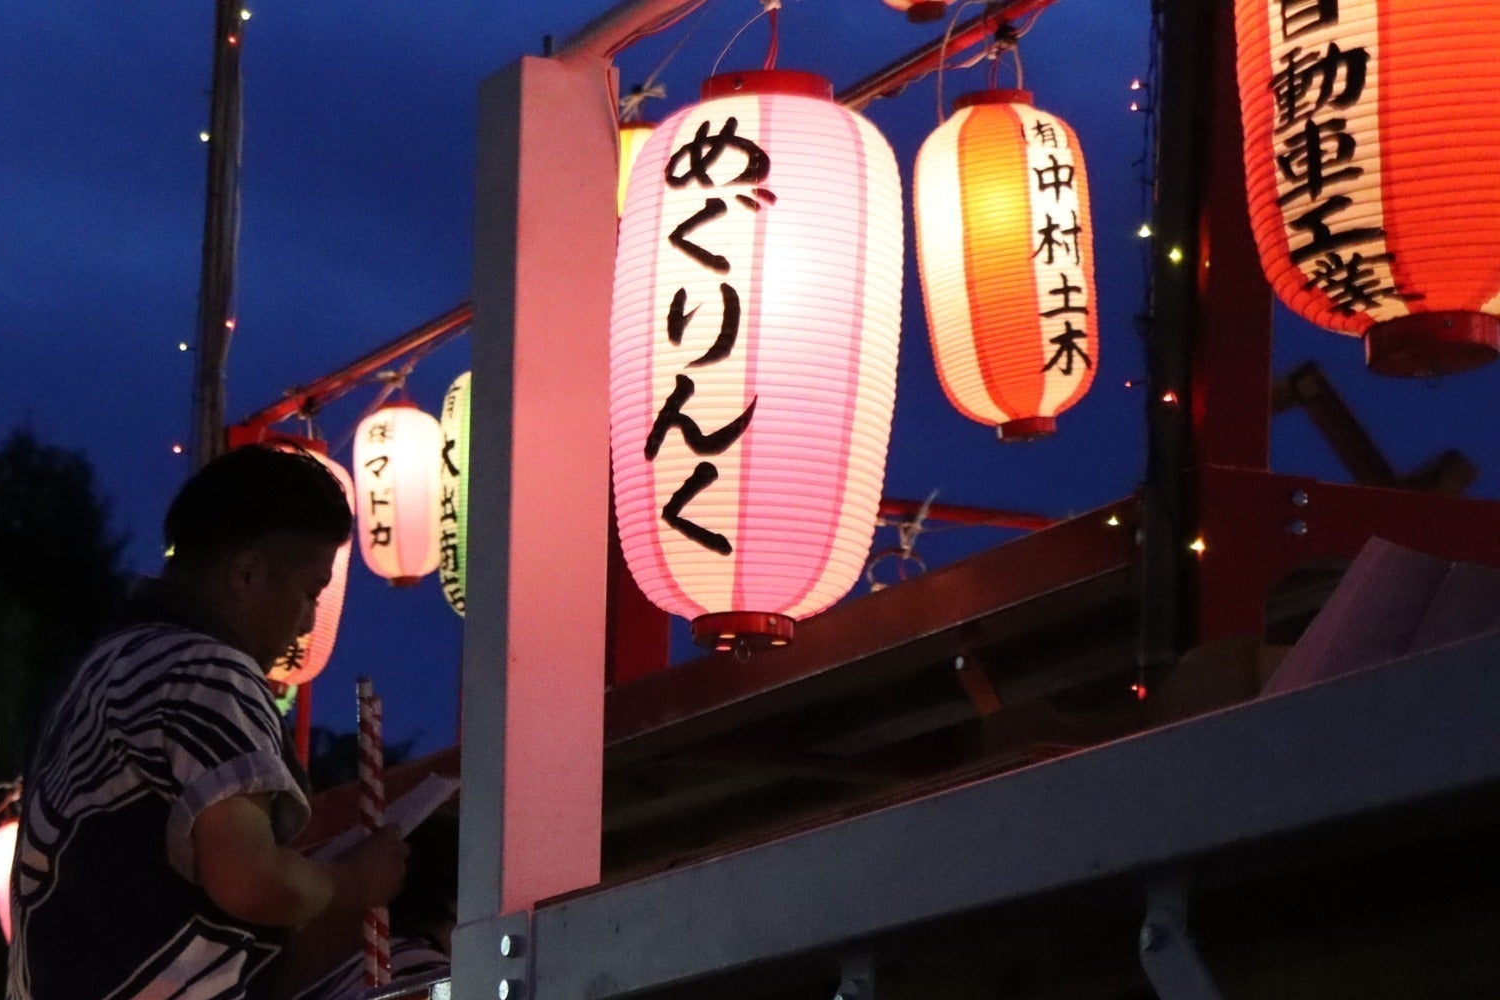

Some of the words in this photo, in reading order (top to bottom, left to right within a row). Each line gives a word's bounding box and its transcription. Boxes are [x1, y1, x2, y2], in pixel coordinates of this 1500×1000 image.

[644, 116, 777, 557] めぐりんく
